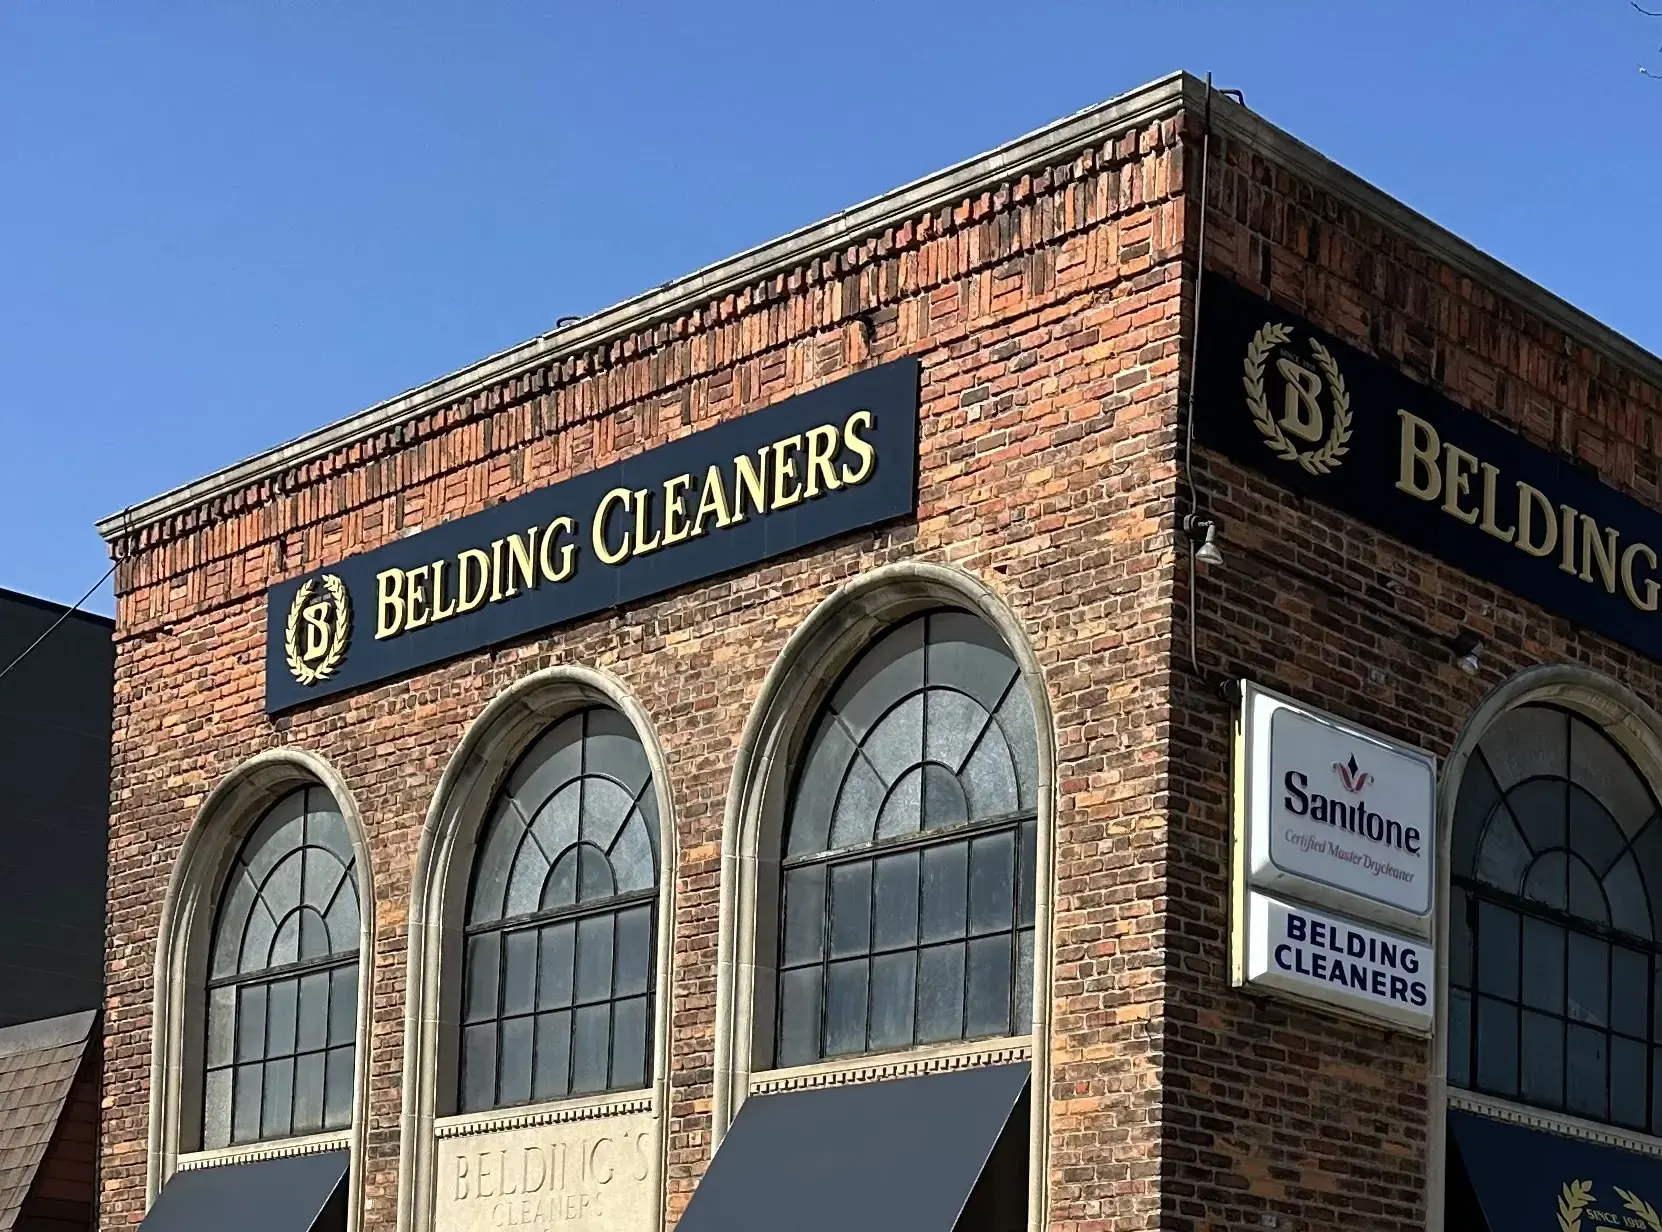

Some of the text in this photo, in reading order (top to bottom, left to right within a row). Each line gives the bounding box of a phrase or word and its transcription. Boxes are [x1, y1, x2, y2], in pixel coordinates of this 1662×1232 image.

[374, 410, 876, 641] BELDING CLEANERS
[1395, 408, 1662, 612] BELDING
[1284, 770, 1421, 855] Sanitone
[1284, 828, 1416, 883] Certified Master Drycleaner
[1274, 943, 1427, 1007] CLEANERS
[1287, 912, 1419, 974] BELDING
[1586, 1208, 1620, 1225] SINCE
